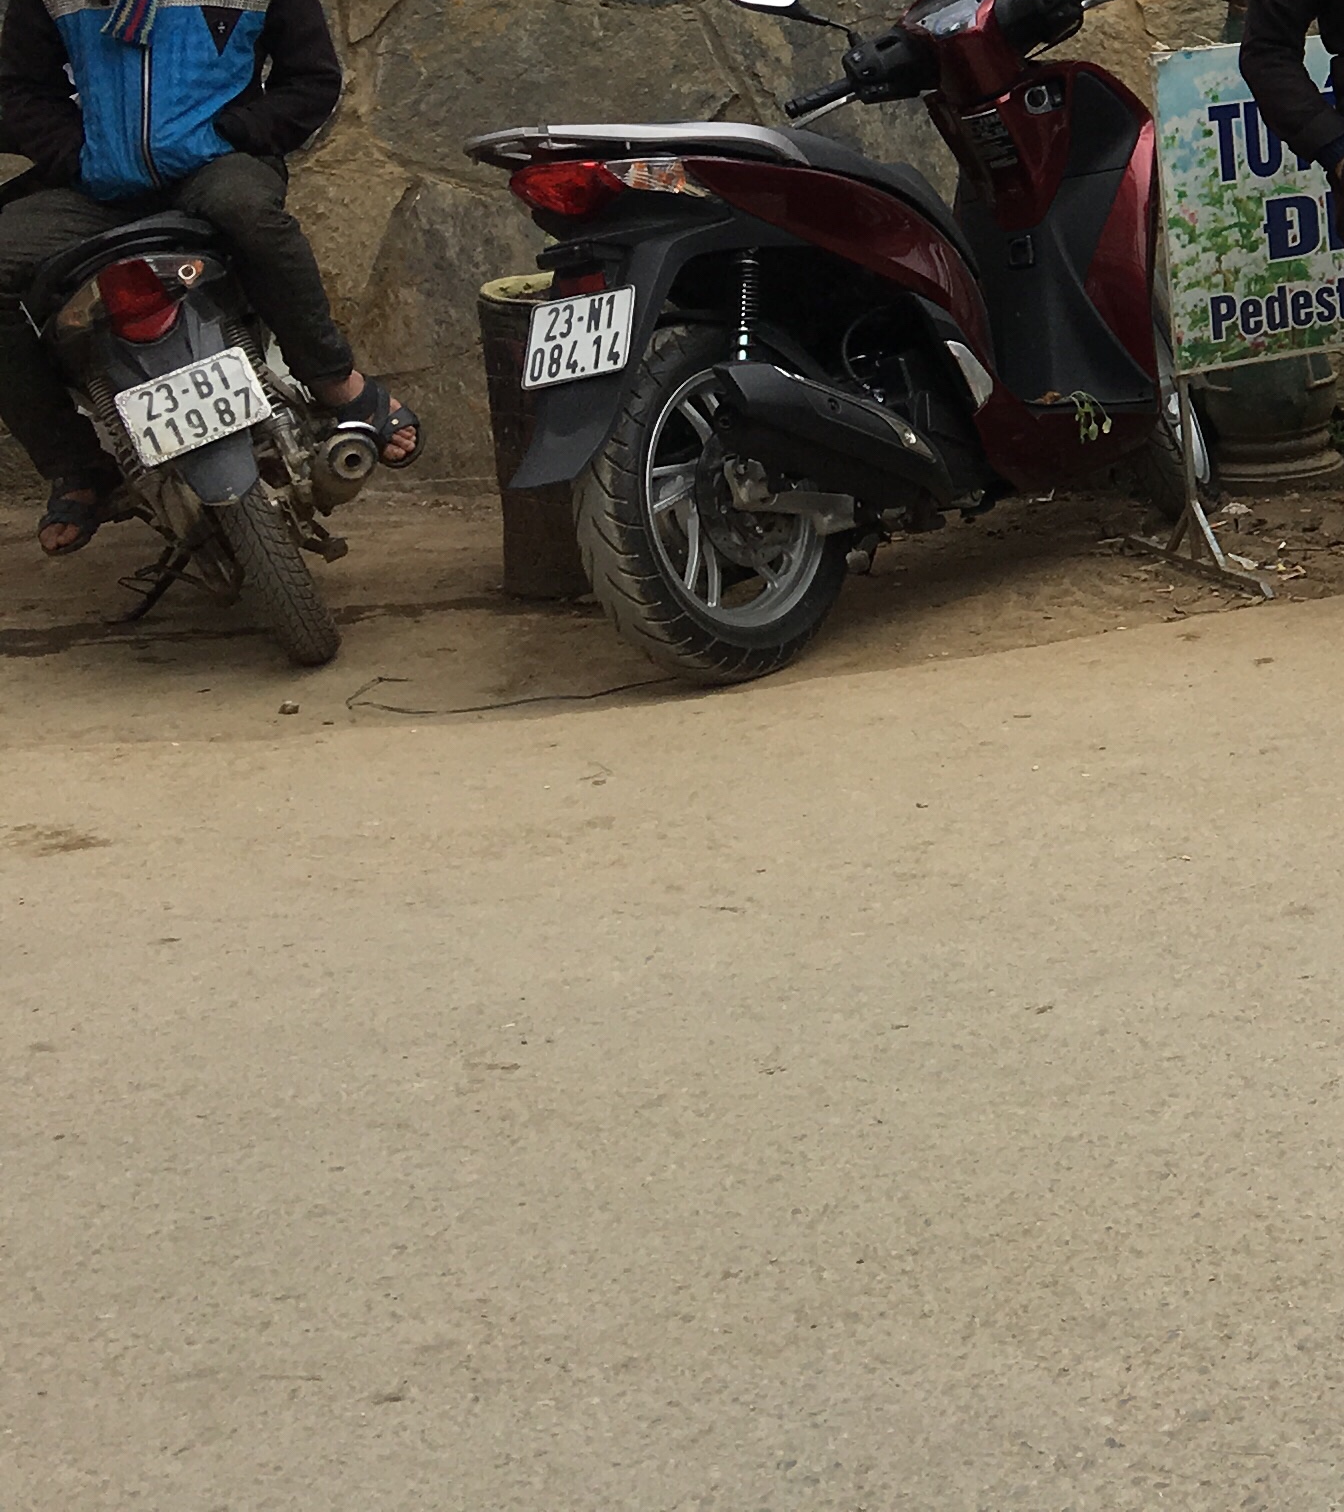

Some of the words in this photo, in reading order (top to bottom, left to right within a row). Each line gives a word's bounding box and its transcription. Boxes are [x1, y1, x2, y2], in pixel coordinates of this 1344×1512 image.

[544, 294, 616, 342] 23-N1
[530, 331, 620, 382] 084.14
[138, 362, 230, 422] 23-B1
[143, 387, 251, 455] 119.87
